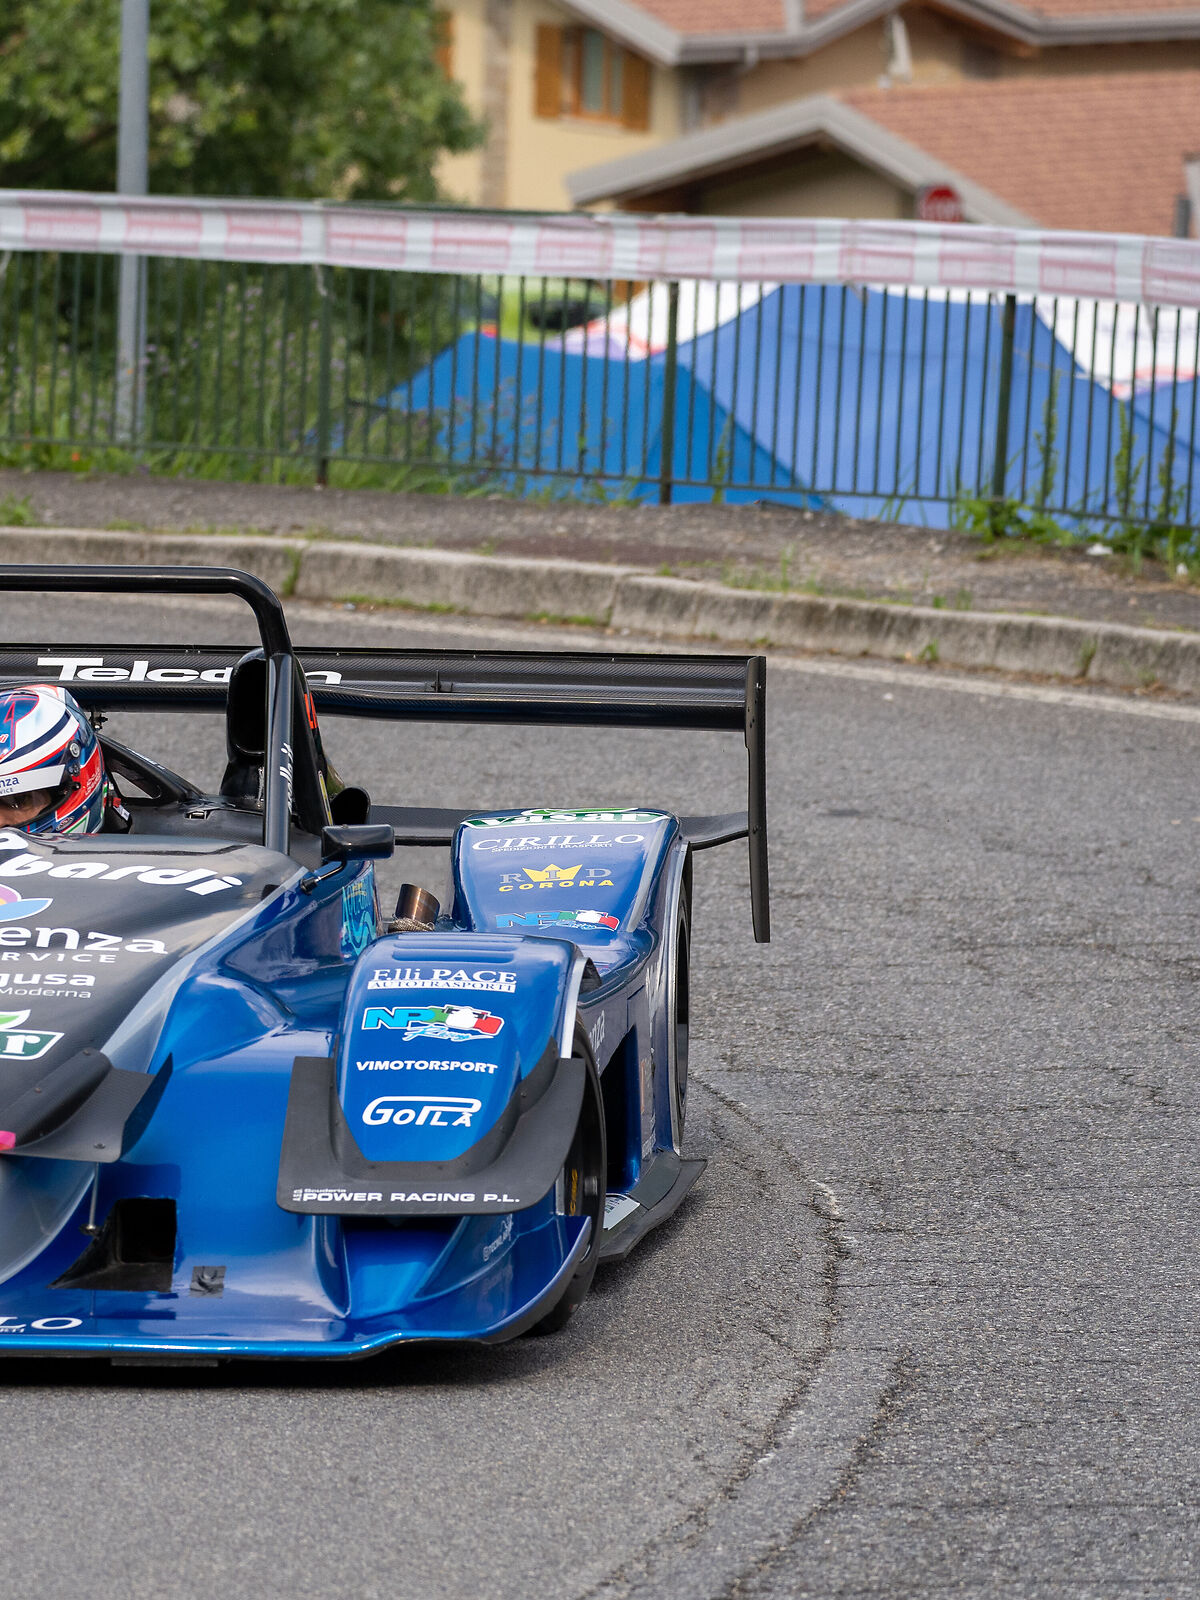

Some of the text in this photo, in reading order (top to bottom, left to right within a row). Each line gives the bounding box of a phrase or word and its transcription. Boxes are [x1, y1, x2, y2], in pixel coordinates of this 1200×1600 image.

[472, 834, 644, 850] CIRILLO
[498, 879, 614, 892] CORONA
[431, 969, 517, 984] PACE
[373, 980, 513, 991] AUTOTRASPORTI
[356, 1060, 498, 1074] VIMOTORSPORT
[302, 1192, 383, 1202] POWER
[390, 1192, 475, 1202] RACING
[483, 1193, 520, 1203] P.L.
